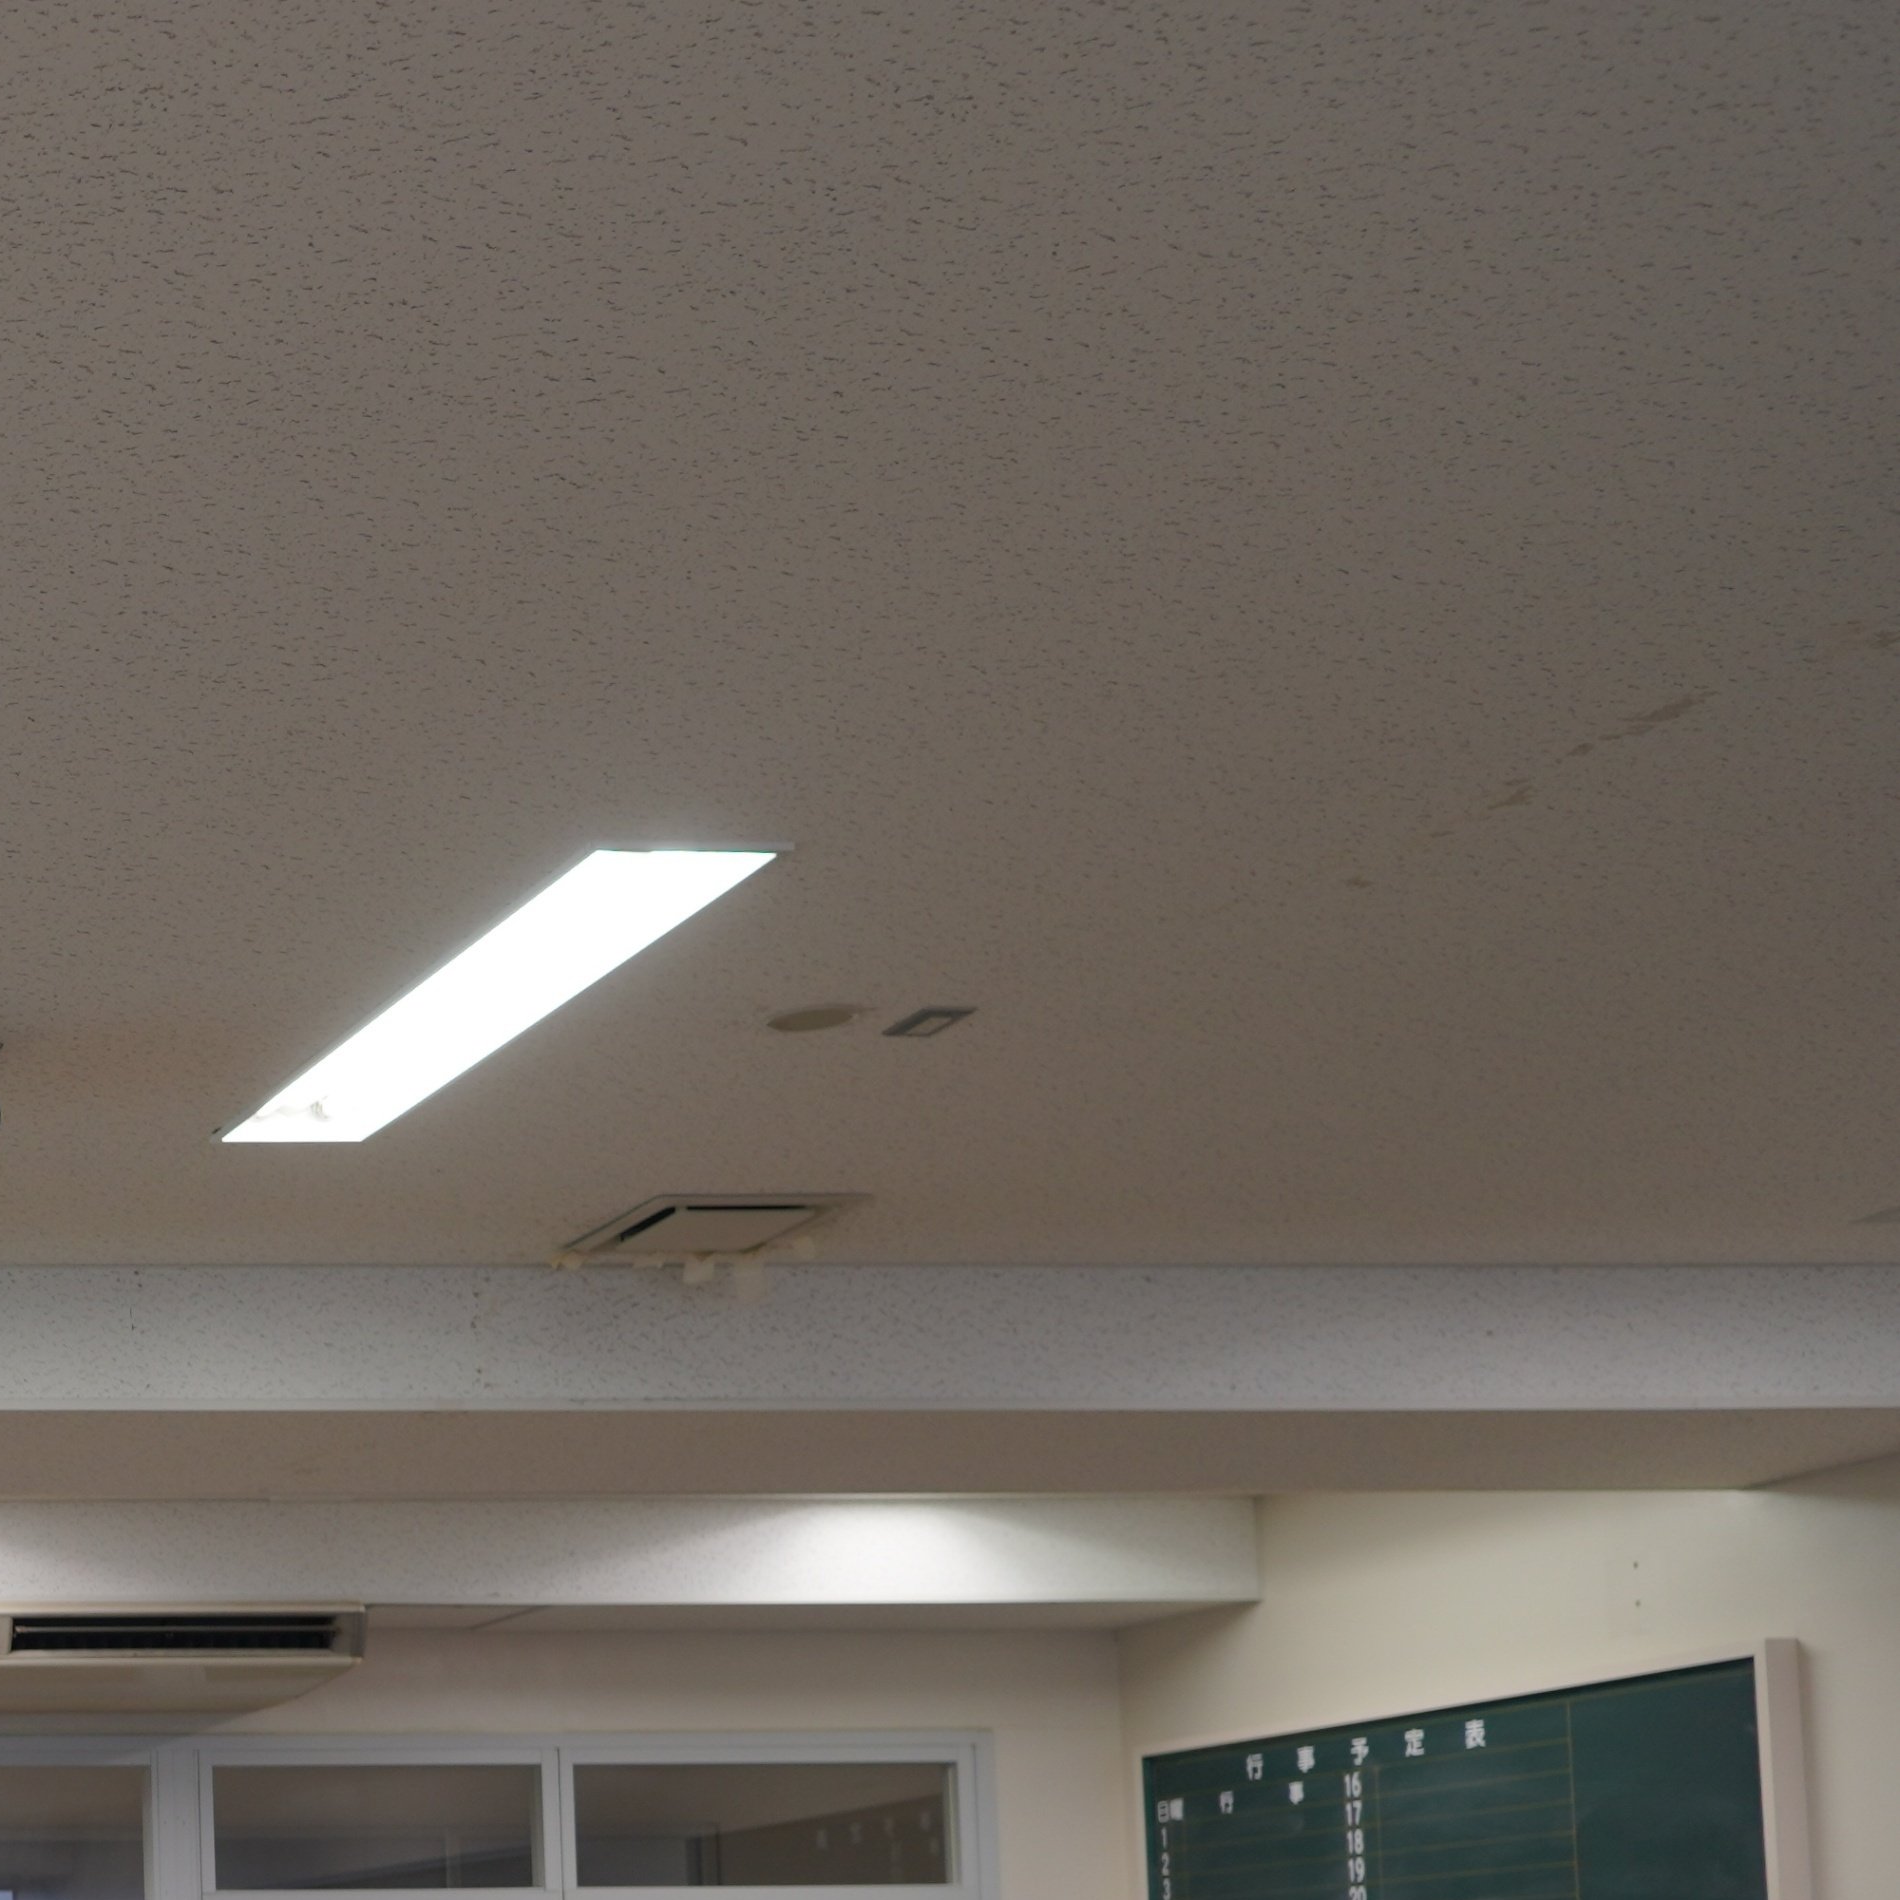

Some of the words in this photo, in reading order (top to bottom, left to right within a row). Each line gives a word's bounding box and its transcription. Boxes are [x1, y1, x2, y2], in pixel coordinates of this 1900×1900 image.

[1344, 1772, 1362, 1797] 16
[1345, 1801, 1362, 1825] 17
[1161, 1827, 1168, 1849] 1
[1347, 1829, 1363, 1854] 18
[1161, 1852, 1170, 1876] 2
[1348, 1857, 1365, 1882] 19
